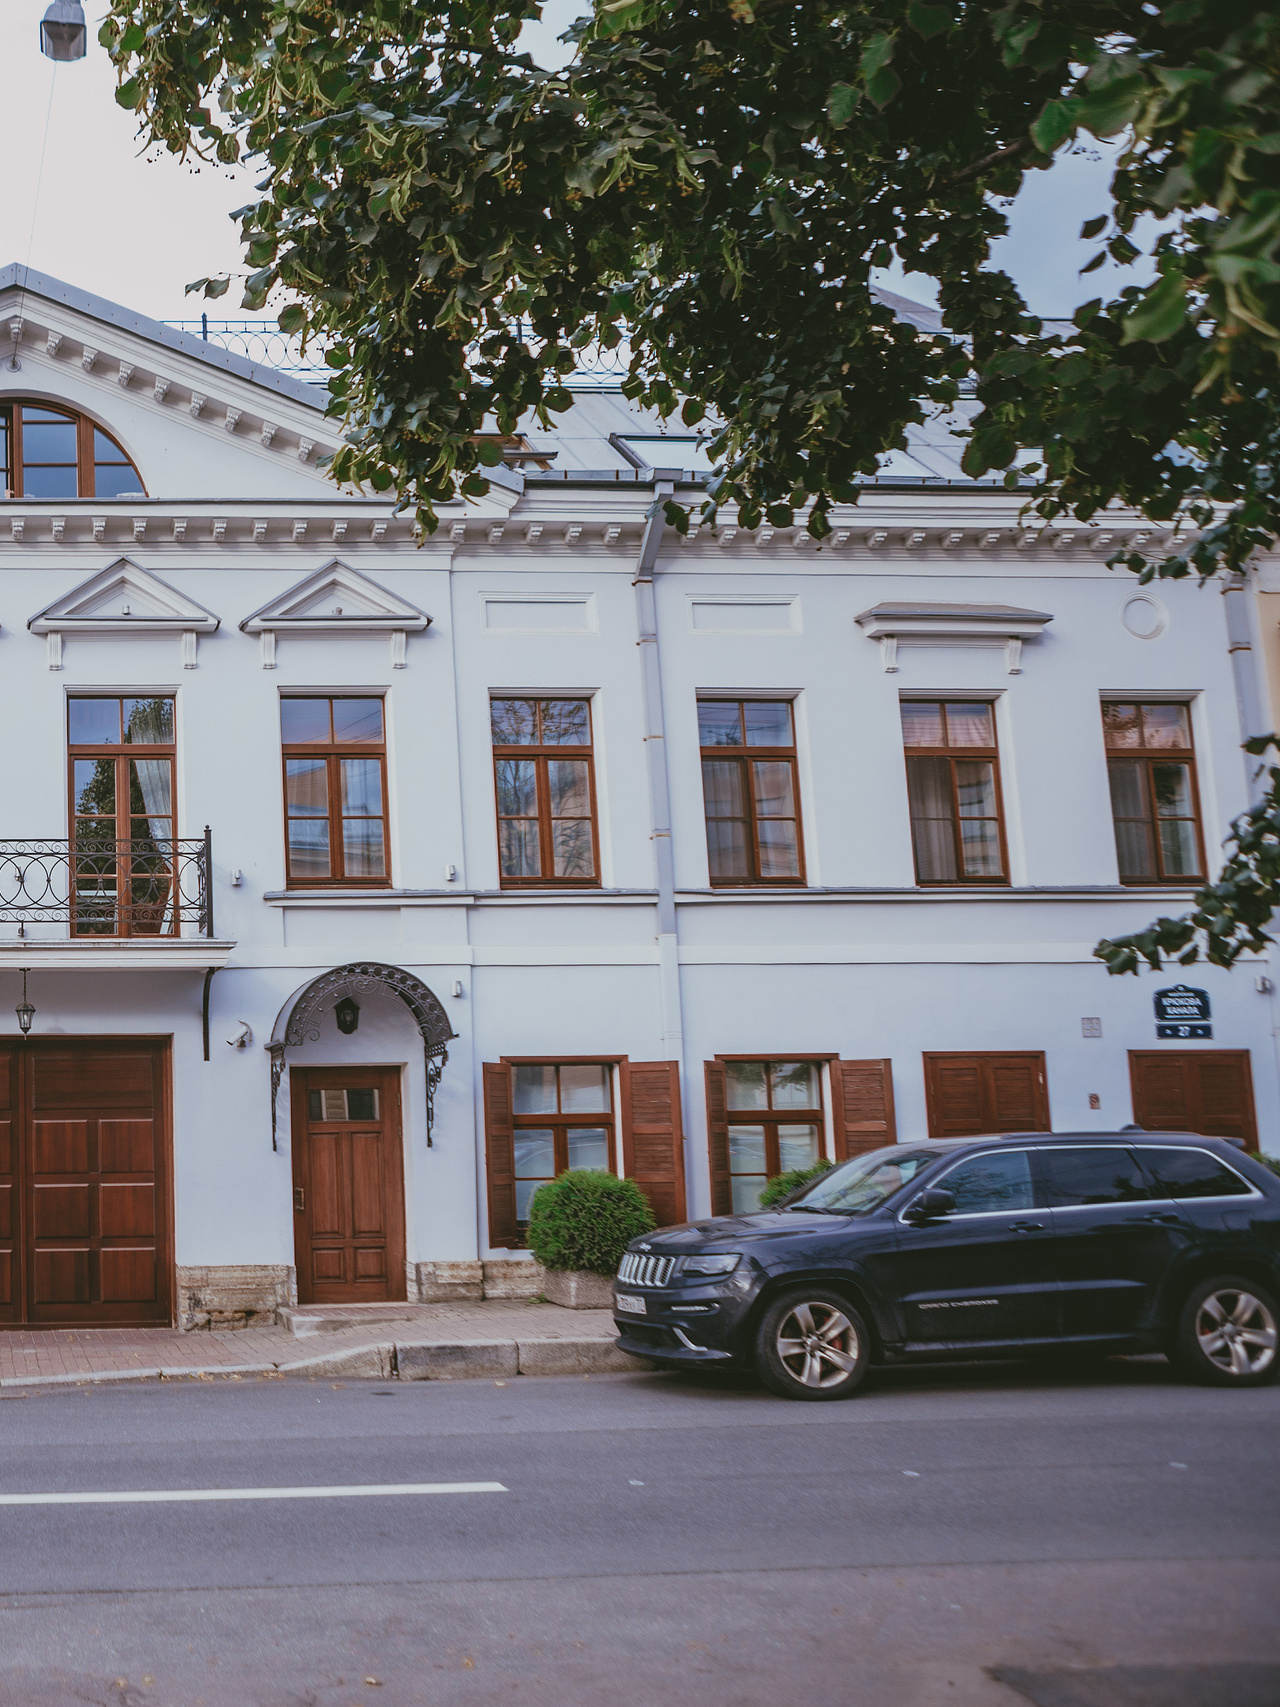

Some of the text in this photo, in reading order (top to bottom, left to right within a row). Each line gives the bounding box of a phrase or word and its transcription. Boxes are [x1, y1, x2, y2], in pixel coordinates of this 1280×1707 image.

[1162, 998, 1202, 1006] КРЮКОВА
[1167, 1006, 1200, 1014] КАНАЛА
[1178, 1025, 1191, 1037] 27
[918, 1302, 950, 1310] GRAND
